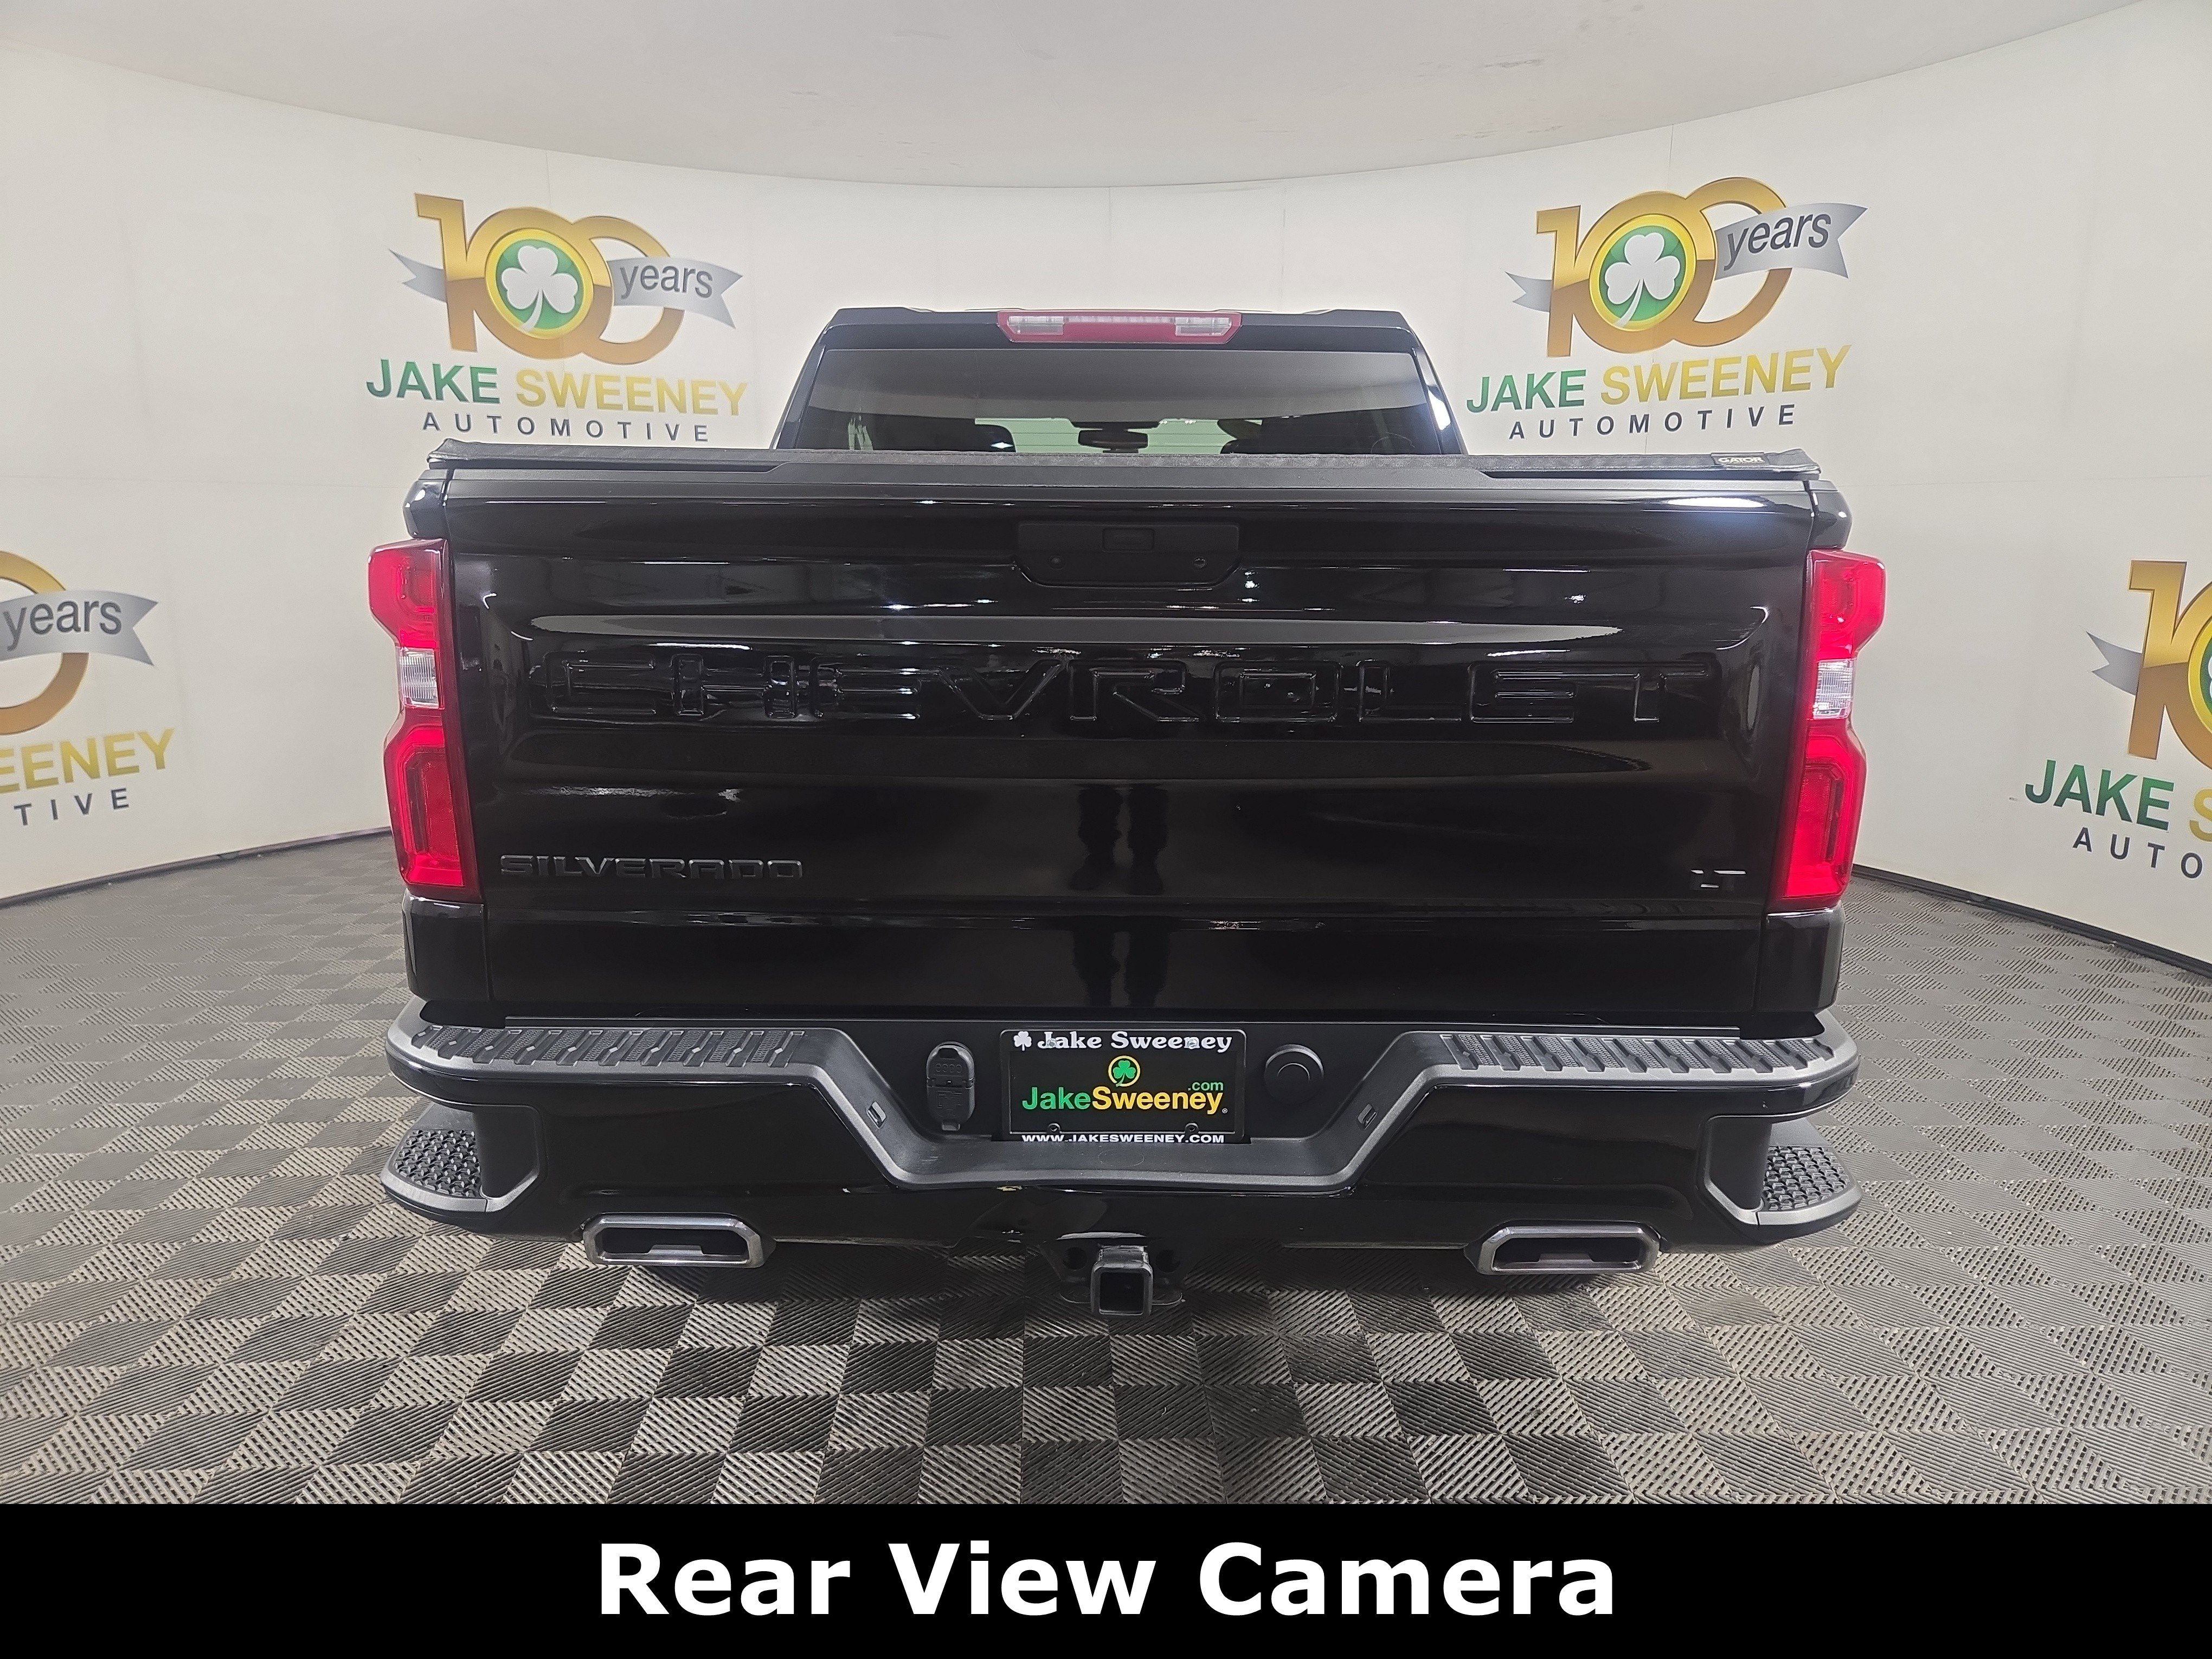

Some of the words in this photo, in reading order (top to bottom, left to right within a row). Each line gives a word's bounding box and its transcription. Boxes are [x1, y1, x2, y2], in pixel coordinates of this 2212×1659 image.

[1723, 213, 1831, 271] years
[415, 193, 684, 365] 100
[620, 263, 713, 299] years
[1536, 177, 1792, 357] 100
[366, 359, 500, 404] JAKE
[516, 369, 748, 415] SWEENEY
[1467, 370, 1586, 413] JAKE
[1600, 345, 1851, 406] SWEENEY
[423, 413, 708, 441] AUTOMOTIVE
[1509, 404, 1795, 439] AUTOMOTIVE
[3, 600, 122, 650] years
[544, 653, 1715, 723] CHEVROLET
[14, 788, 130, 825] TIVE
[2025, 760, 2174, 831] JAKE
[500, 854, 803, 879] SILVERADO
[2073, 827, 2203, 878] AUTO
[1690, 870, 1746, 890] LT
[1037, 1031, 1102, 1049] Jake
[1110, 1031, 1232, 1052] Sweeney
[1187, 1082, 1224, 1091] .com
[1022, 1134, 1224, 1143] WWW.JAKESWEENEY.COM
